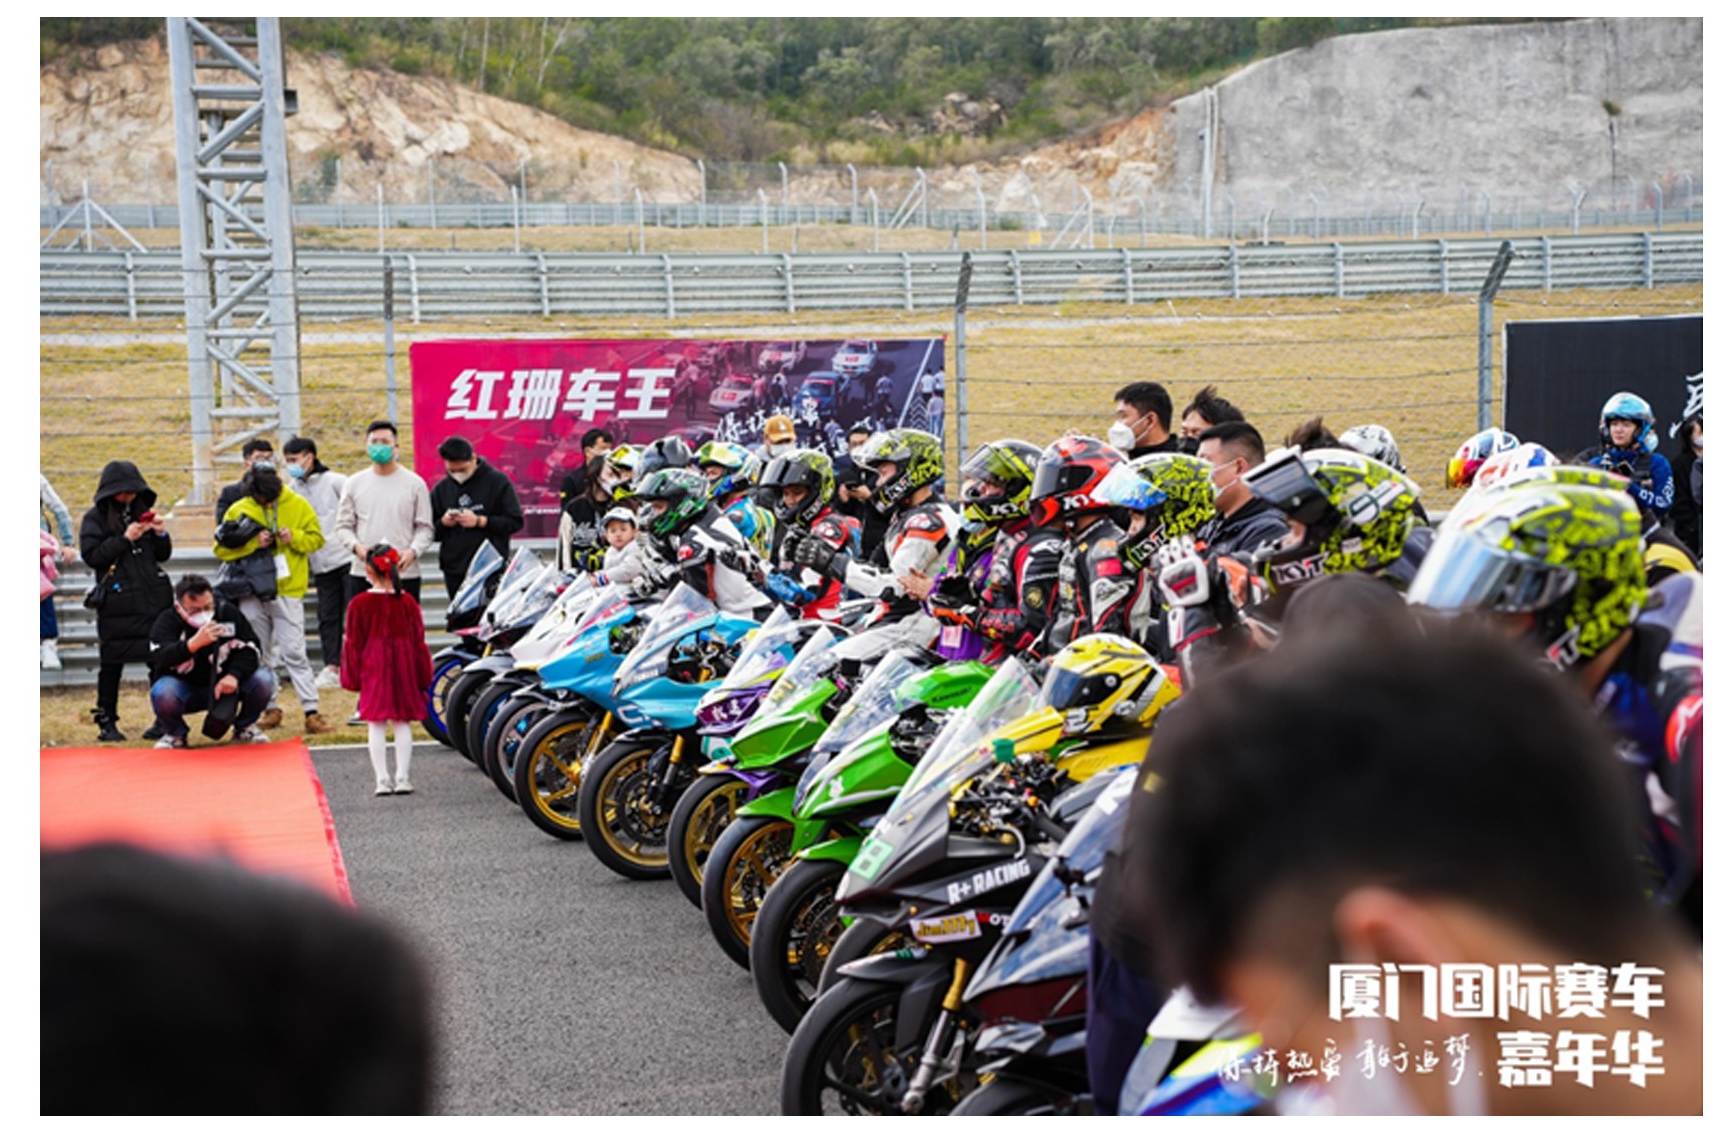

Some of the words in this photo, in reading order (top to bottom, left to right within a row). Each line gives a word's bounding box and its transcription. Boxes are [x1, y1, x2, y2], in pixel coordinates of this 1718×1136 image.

[444, 367, 678, 421] 红珊车王
[1271, 550, 1330, 585] KYT
[972, 858, 1031, 895] RACING
